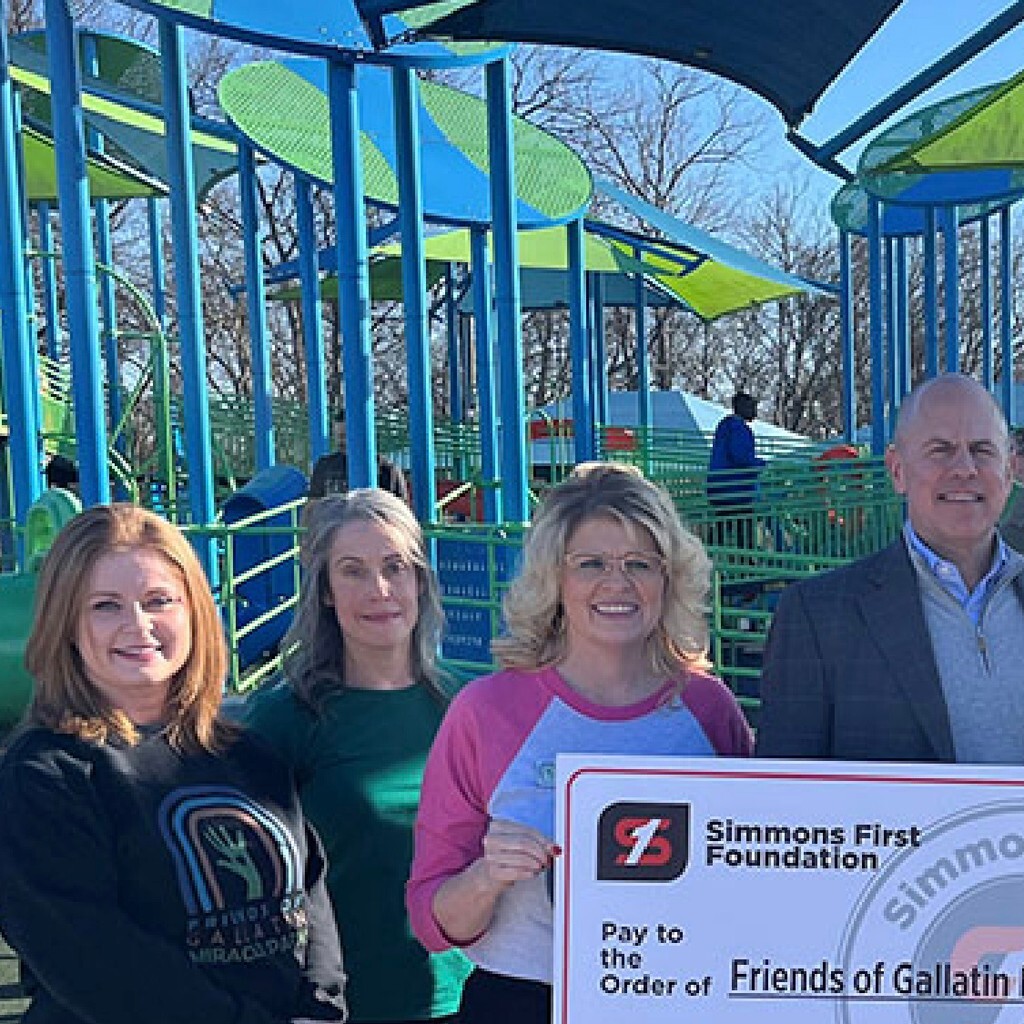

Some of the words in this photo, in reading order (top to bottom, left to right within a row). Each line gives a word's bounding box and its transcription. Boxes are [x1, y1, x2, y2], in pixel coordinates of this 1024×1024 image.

[706, 819, 846, 845] Simmons
[855, 824, 922, 848] First
[706, 846, 878, 870] Foundation
[602, 923, 648, 945] Pay
[657, 925, 684, 944] to
[601, 949, 642, 969] the
[600, 974, 677, 995] Order
[685, 976, 712, 996] of
[731, 958, 845, 994] Friends
[854, 962, 884, 994] of
[893, 963, 1009, 997] Gallatin
